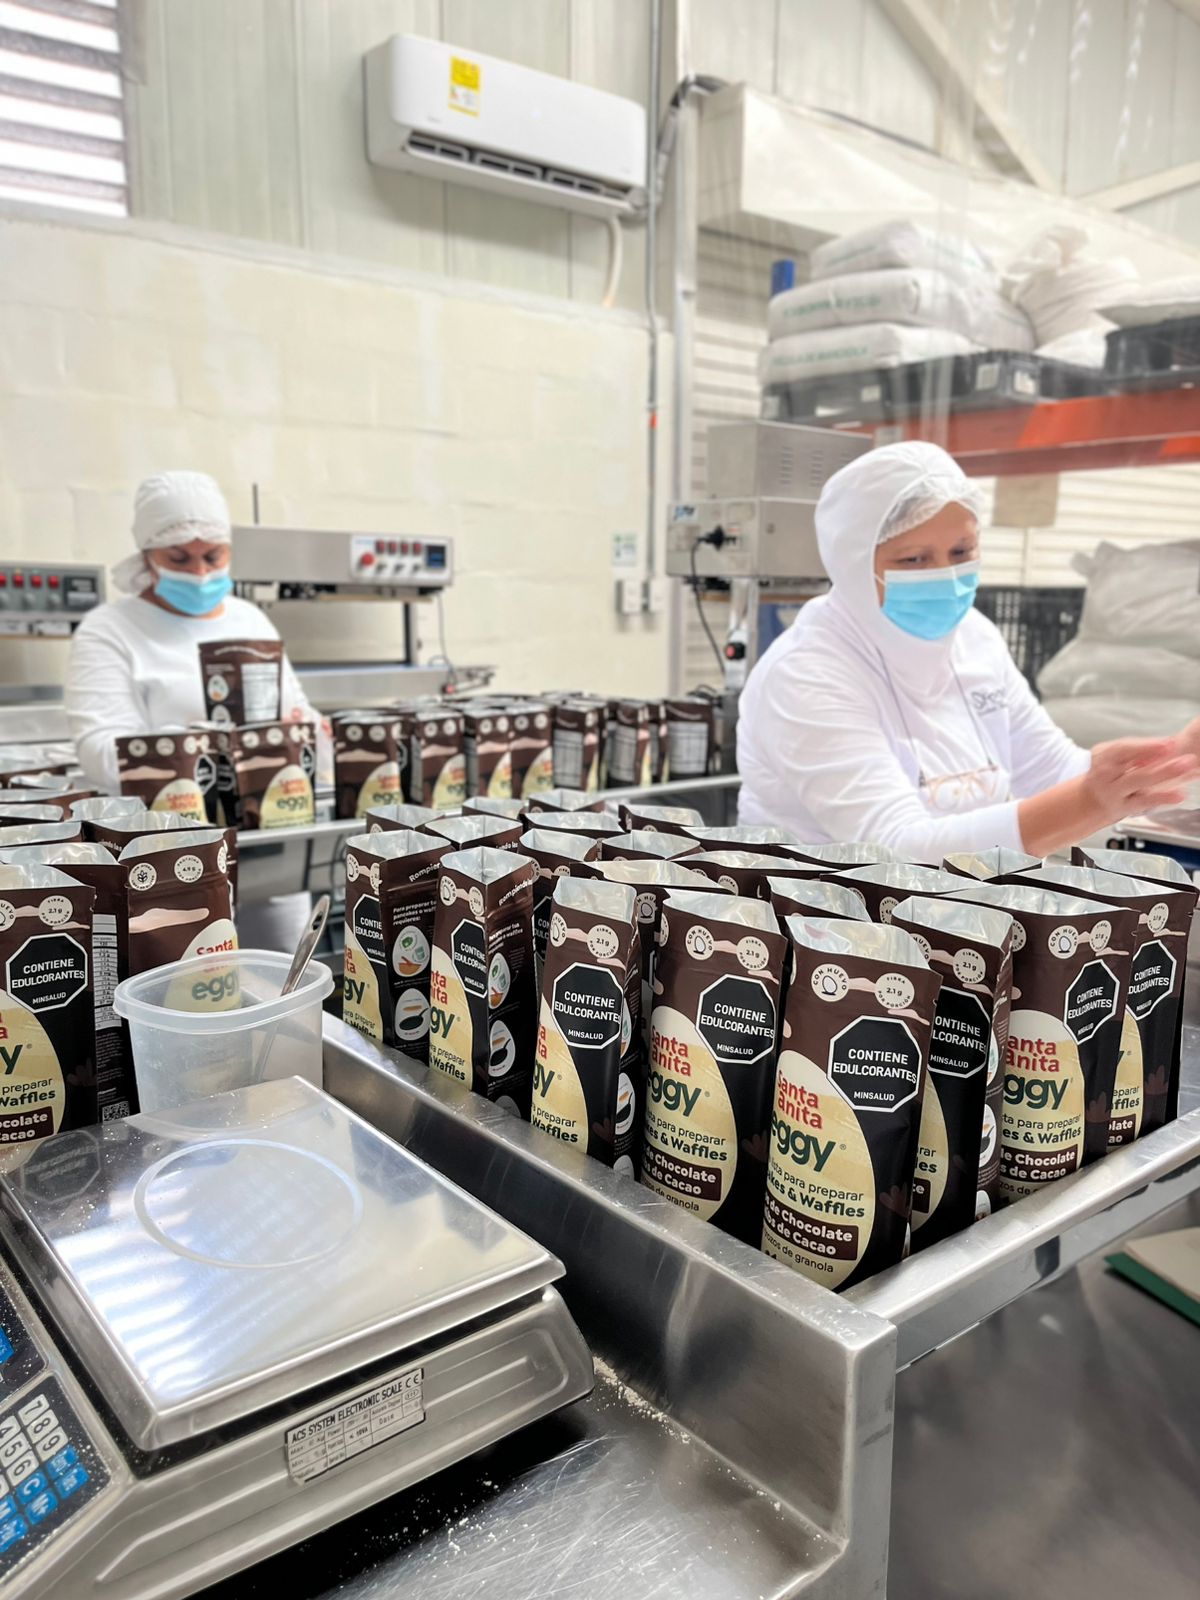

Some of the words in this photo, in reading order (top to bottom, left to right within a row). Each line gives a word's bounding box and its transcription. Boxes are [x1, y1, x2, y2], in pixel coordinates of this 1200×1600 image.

[1050, 932, 1060, 947] CON
[23, 958, 75, 974] CONTIENE
[1134, 965, 1161, 981] CONTIENE
[11, 970, 86, 989] EDULCORANTES
[813, 970, 824, 985] CON
[827, 967, 847, 990] HUEVO
[32, 991, 67, 1004] MINSALUD
[564, 991, 616, 1009] CONTIENE
[1077, 987, 1104, 1004] CONTIENE
[714, 1003, 767, 1023] CONTIENE
[1068, 999, 1112, 1019] EDULCORANTES
[568, 1029, 604, 1040] MINSALUD
[700, 1014, 774, 1038] EDULCORANTES
[716, 1043, 754, 1055] MINSALUD
[848, 1048, 909, 1065] CONTIENE
[930, 1054, 969, 1069] MINSALUD
[1005, 1053, 1060, 1073] anita
[833, 1062, 917, 1084] EDULCORANTES
[2, 1078, 53, 1095] preparar
[853, 1091, 895, 1101] MINSALUD
[536, 1108, 577, 1128] preparar
[778, 1093, 822, 1129] anita
[1017, 1119, 1044, 1129] para
[1047, 1114, 1081, 1131] preparar
[657, 1118, 676, 1133] para
[678, 1128, 726, 1146] preparar
[1023, 1131, 1035, 1144] &
[1038, 1127, 1082, 1144] Waffles
[660, 1132, 669, 1146] &
[671, 1136, 728, 1161] Waffles
[1015, 1151, 1075, 1166] Chocolate
[655, 1153, 716, 1183] Chocolate
[1009, 1166, 1028, 1179] de
[1030, 1168, 1066, 1180] Cacao
[652, 1166, 663, 1181] de
[664, 1173, 702, 1195] Cacao
[784, 1172, 805, 1189] para
[808, 1184, 864, 1202] preparar
[1017, 1185, 1031, 1195] de
[787, 1187, 797, 1202] &
[799, 1192, 865, 1218] Waffles
[769, 1200, 780, 1215] de
[781, 1209, 853, 1242] Chocolate
[777, 1223, 791, 1238] de
[792, 1231, 837, 1255] Cacao
[782, 1246, 793, 1257] de
[795, 1253, 834, 1273] granola
[24, 1400, 44, 1416] 7
[291, 1429, 307, 1444] ACS
[308, 1413, 336, 1436] SYSTEM
[338, 1393, 381, 1421] ELECTRONIC
[381, 1382, 402, 1400] SCALE
[33, 1417, 51, 1434] 8
[4, 1441, 23, 1457] 5
[42, 1435, 61, 1451] 9
[13, 1459, 32, 1476] 6
[23, 1478, 40, 1495] C
